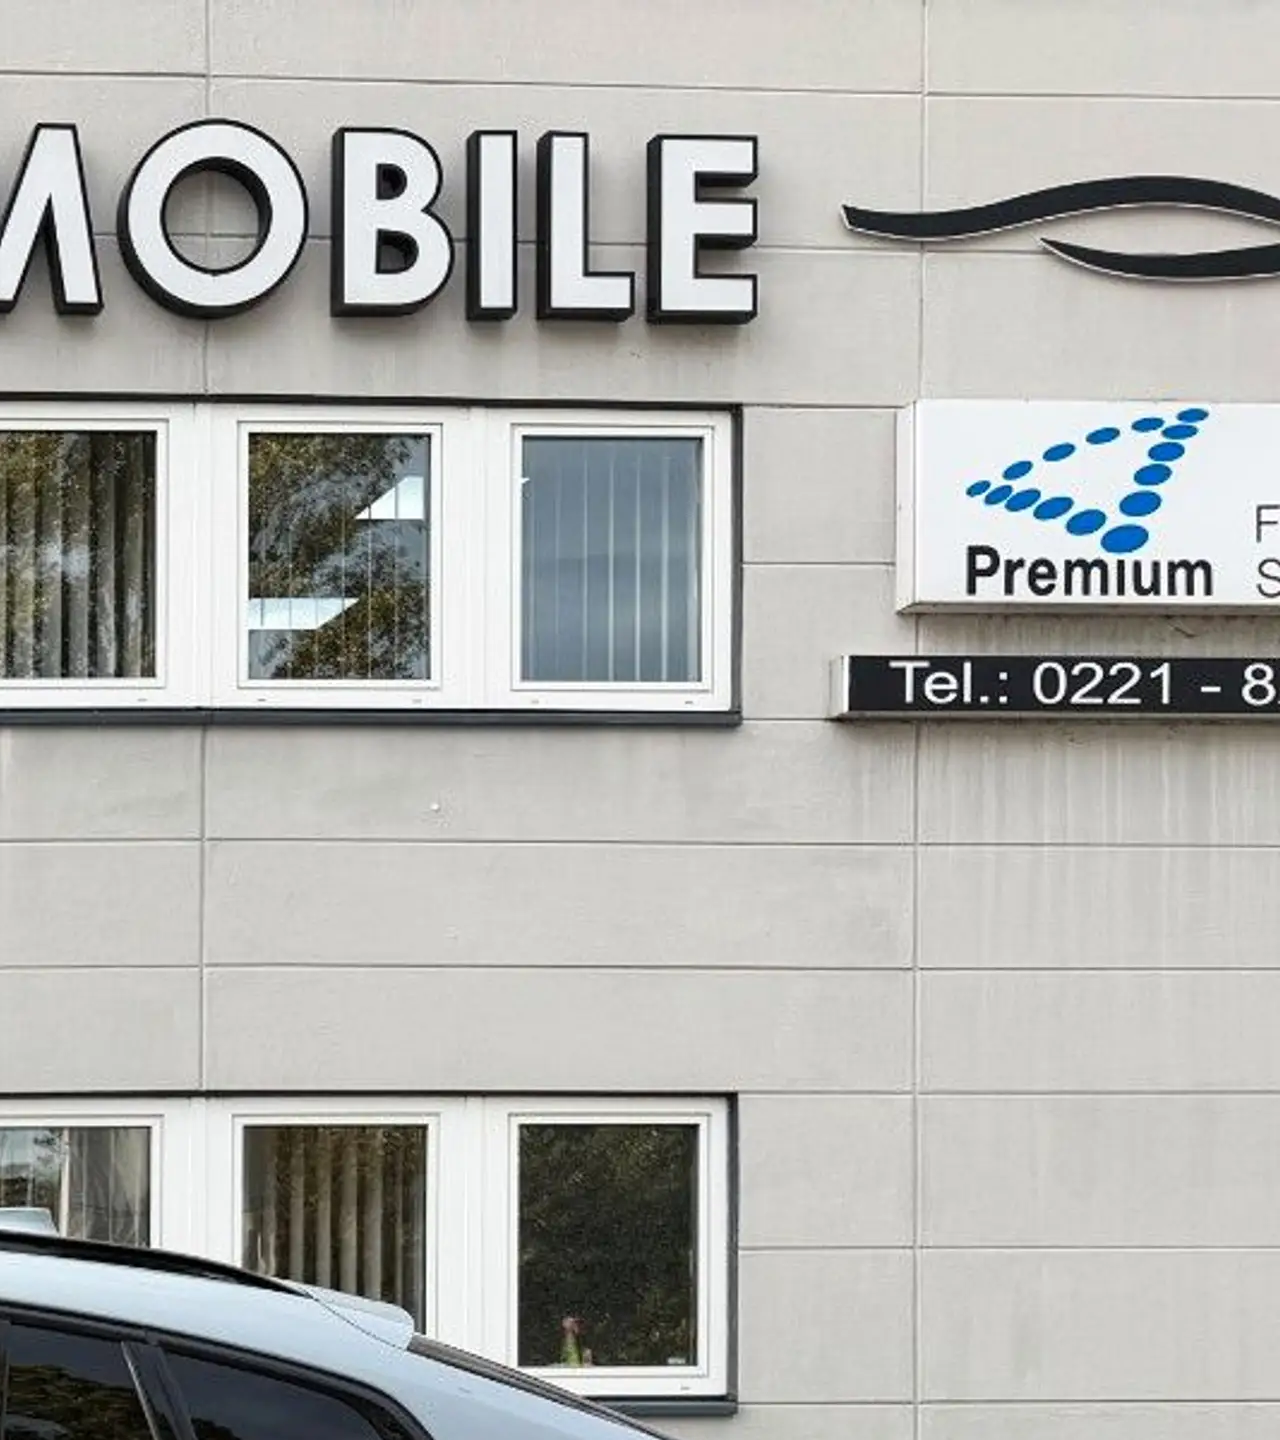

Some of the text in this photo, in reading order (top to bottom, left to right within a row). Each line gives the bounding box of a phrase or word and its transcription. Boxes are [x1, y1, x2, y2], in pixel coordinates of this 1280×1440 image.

[966, 545, 1213, 597] Premium
[889, 661, 1008, 704] Tel.:
[1033, 661, 1172, 706] 0221
[1241, 661, 1280, 706] 8
